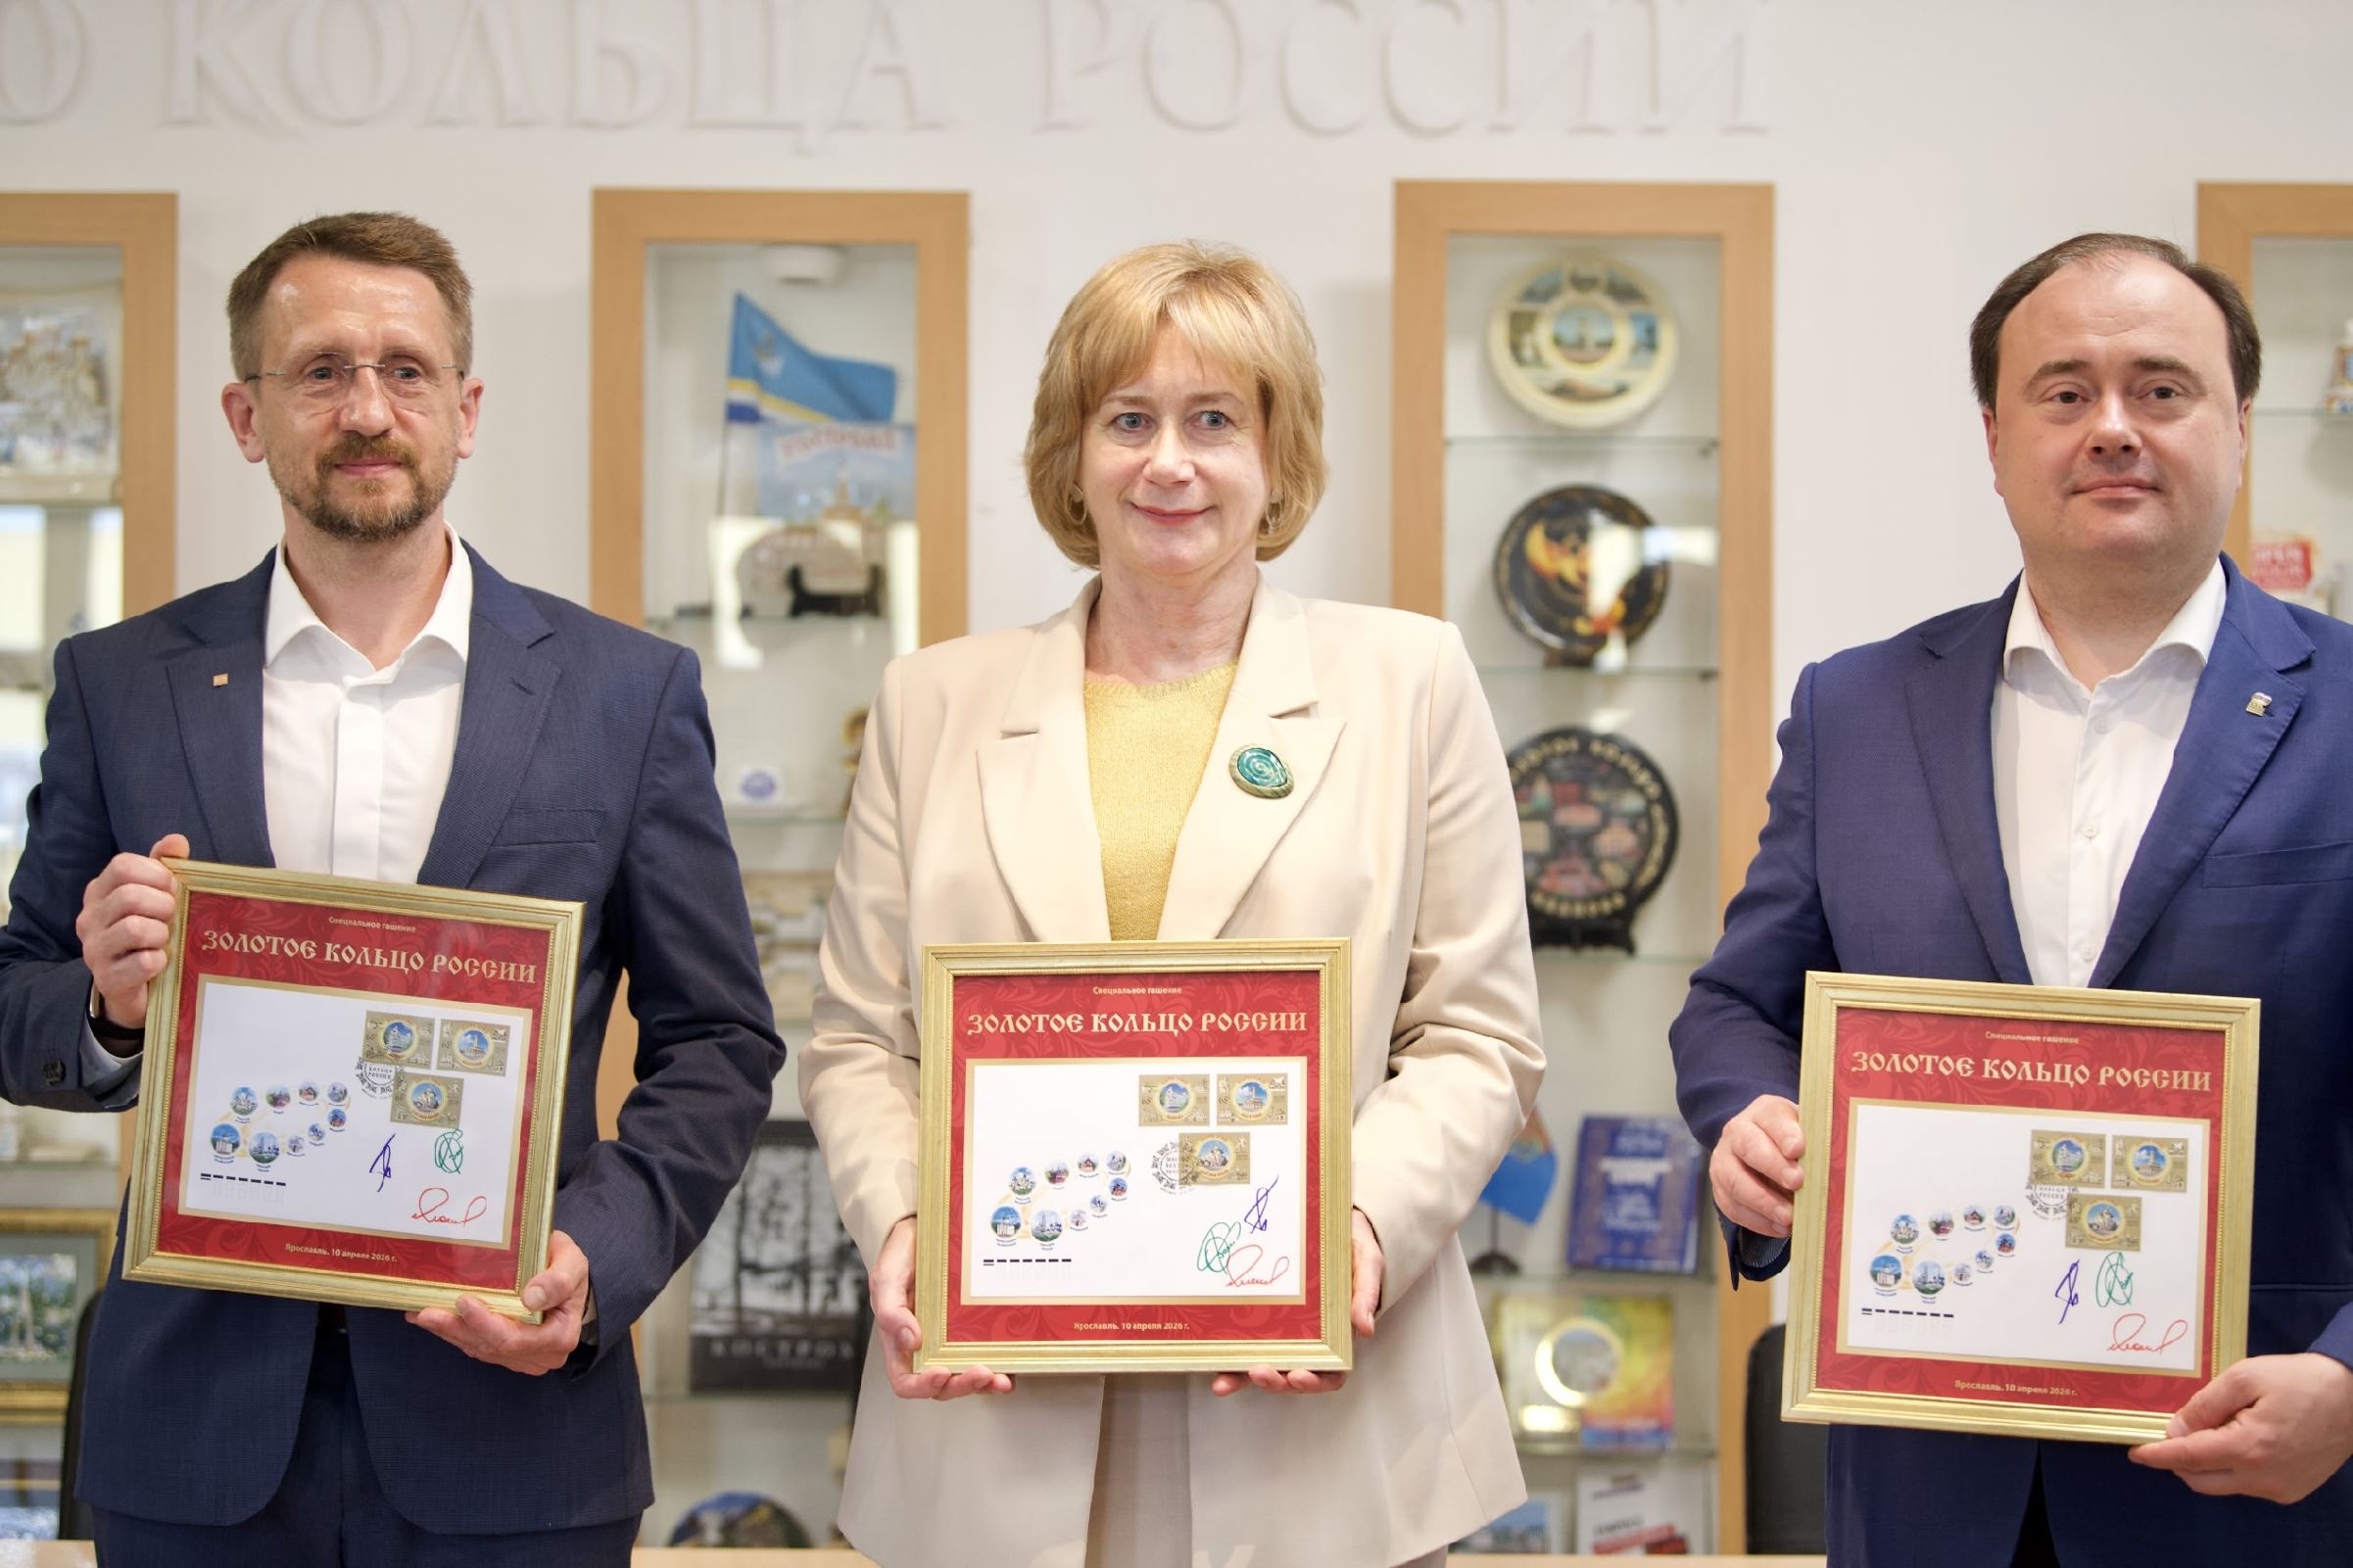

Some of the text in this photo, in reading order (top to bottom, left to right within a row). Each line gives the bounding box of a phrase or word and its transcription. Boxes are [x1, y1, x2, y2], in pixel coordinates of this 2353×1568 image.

[153, 0, 958, 157] КОЛЬЦА
[1032, 0, 1779, 139] РОССИИ
[328, 916, 381, 929] Специальное
[201, 929, 537, 983] ЗОЛОТОЕ КОЛЬЦО РОССИИ
[1092, 986, 1146, 996] Специальное
[967, 1012, 1307, 1038] ЗОЛОТОЕ КОЛЬЦО РОССИИ
[1985, 1030, 2041, 1043] Специальное
[1850, 1051, 2212, 1092] ЗОЛОТОЕ КОЛЬЦО РОССИИ
[1132, 1322, 1162, 1331] апреля
